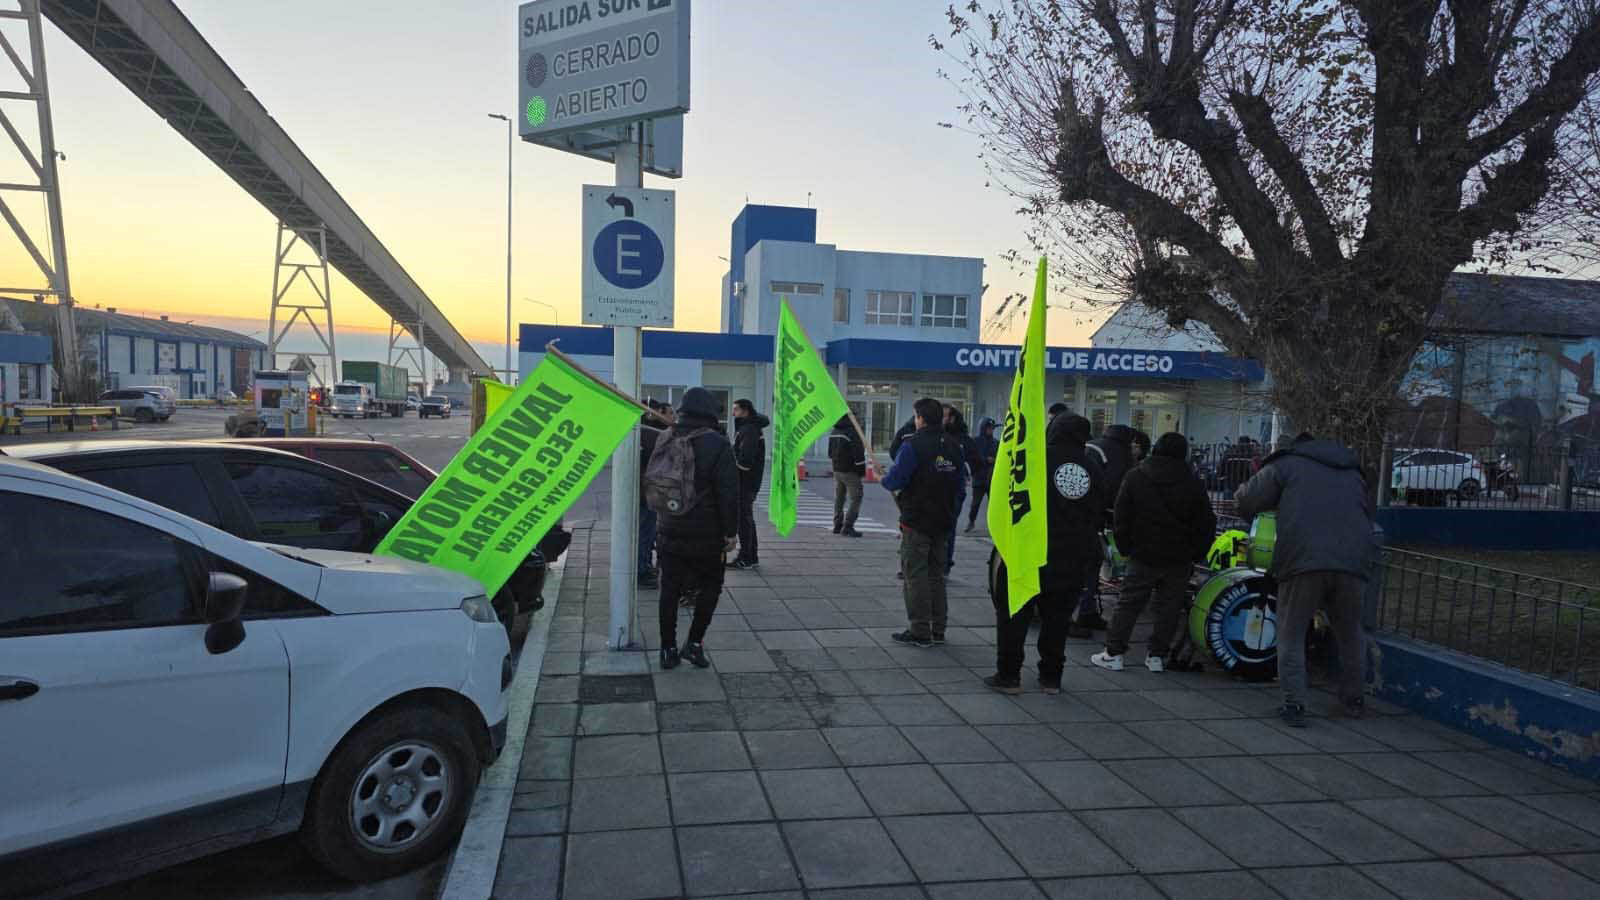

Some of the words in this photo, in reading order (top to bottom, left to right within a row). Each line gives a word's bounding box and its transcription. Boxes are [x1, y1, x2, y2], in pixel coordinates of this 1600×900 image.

[523, 1, 591, 37] SALIDA
[553, 31, 660, 77] CERRADO
[554, 78, 648, 119] ABIERTO
[616, 233, 642, 275] E
[955, 348, 1056, 369] CONTL
[1061, 352, 1089, 370] DE
[1093, 354, 1174, 373] ACCESO
